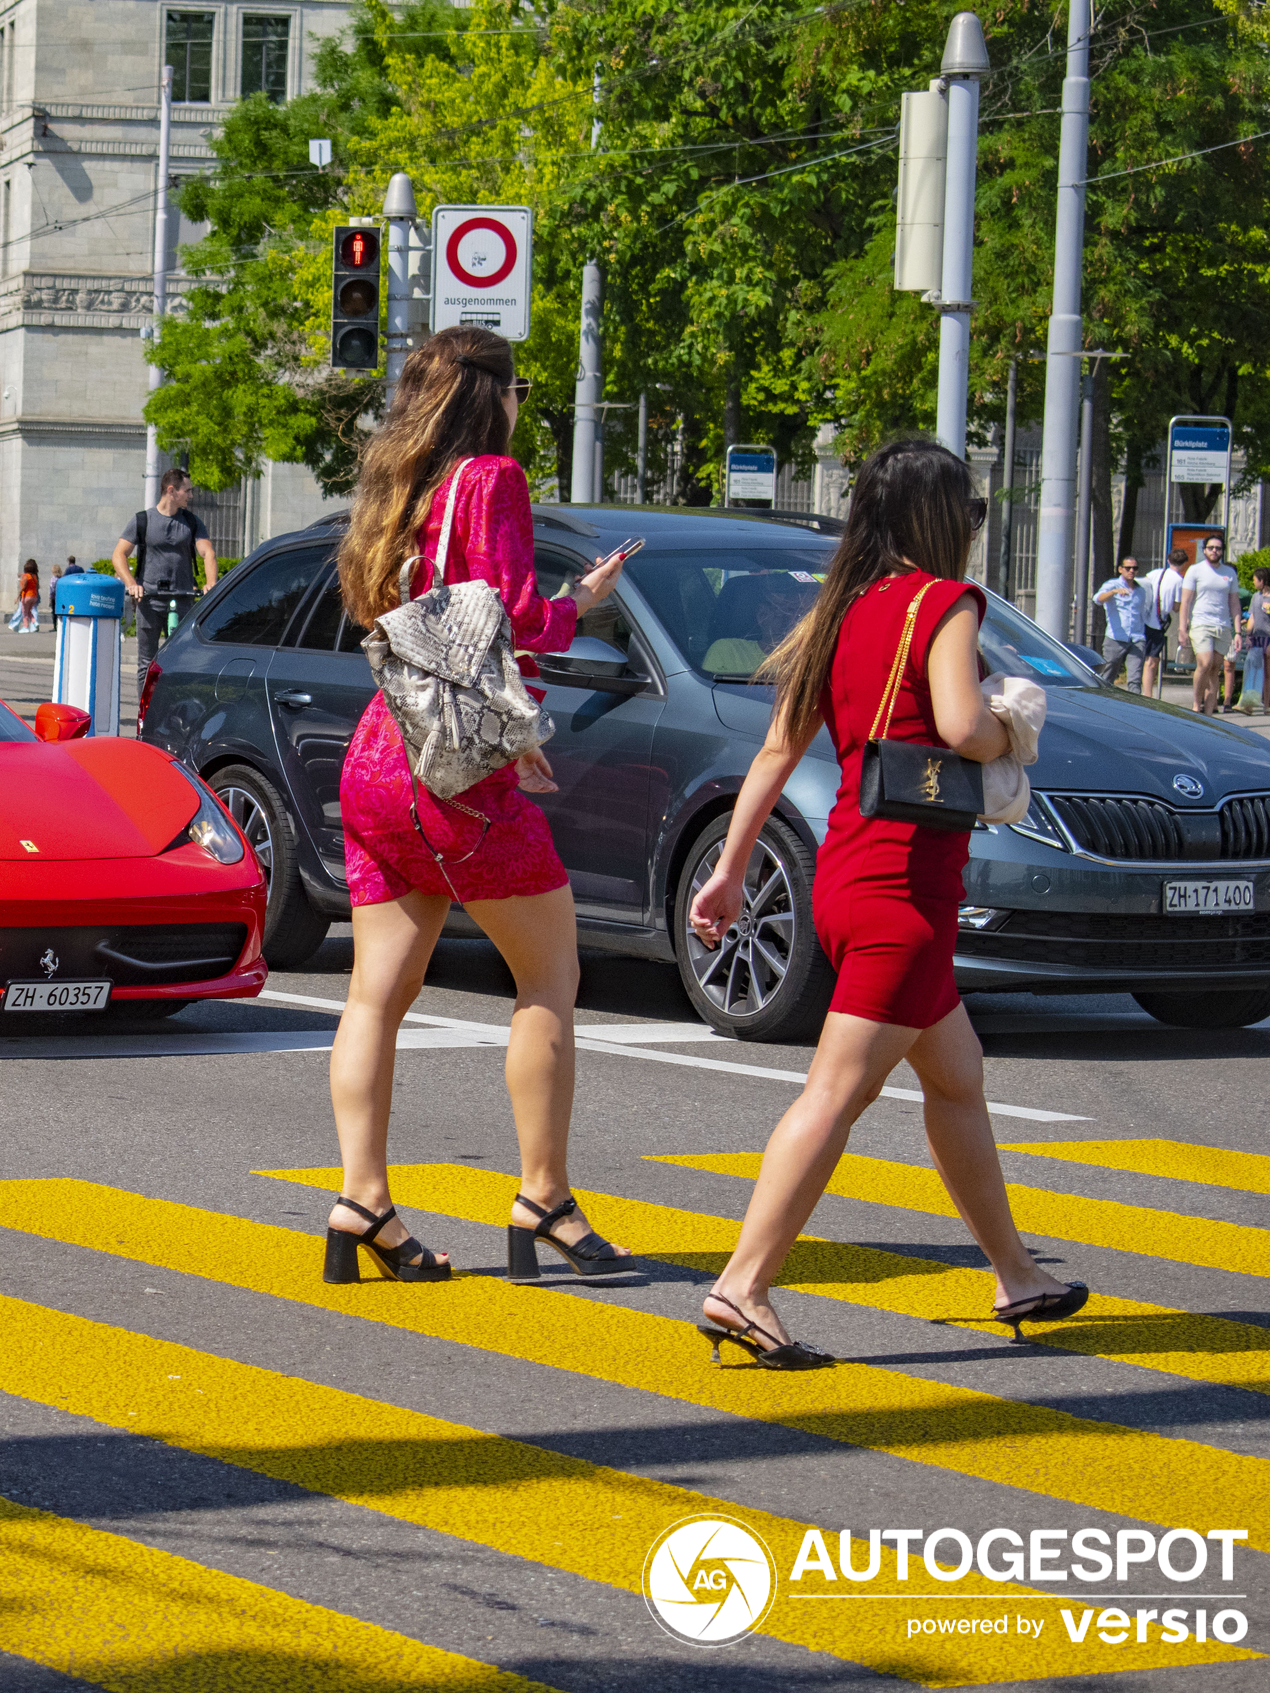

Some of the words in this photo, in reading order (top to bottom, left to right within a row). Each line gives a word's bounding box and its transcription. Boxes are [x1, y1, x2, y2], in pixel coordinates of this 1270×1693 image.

[443, 297, 517, 308] ausgenommen
[1174, 439, 1208, 448] Bürkliplatz
[68, 604, 75, 614] 2
